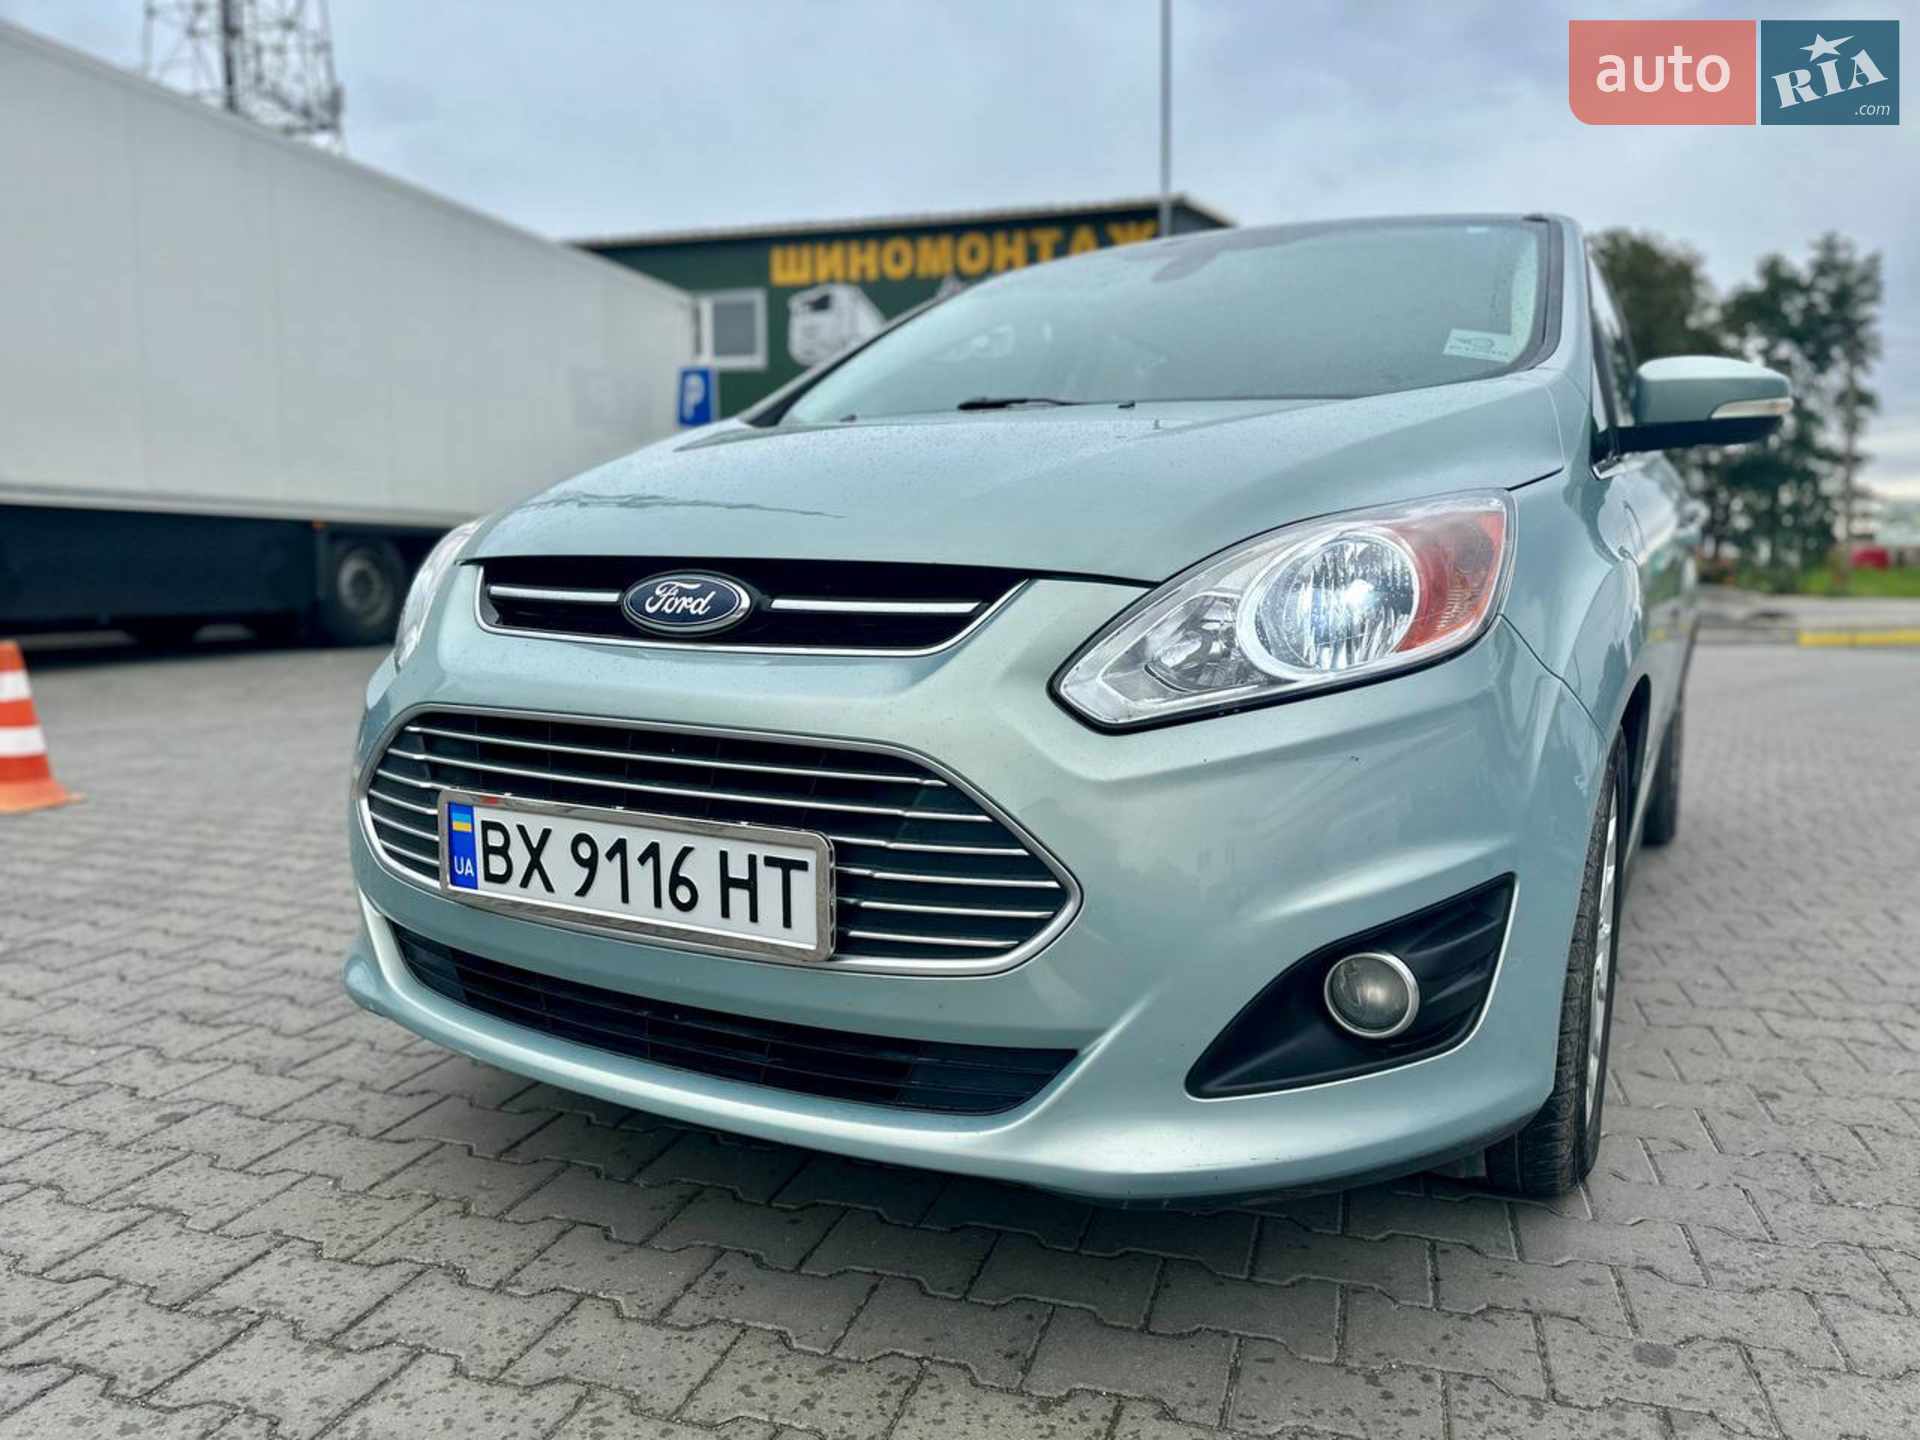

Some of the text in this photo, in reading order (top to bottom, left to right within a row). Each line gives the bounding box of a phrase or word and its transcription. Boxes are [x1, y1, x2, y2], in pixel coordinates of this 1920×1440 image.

[769, 219, 1159, 287] ШИНОМОНТАЖ
[683, 373, 705, 420] P
[645, 581, 716, 615] Ford
[453, 855, 475, 877] UA
[481, 819, 809, 929] BX 9116 HT
